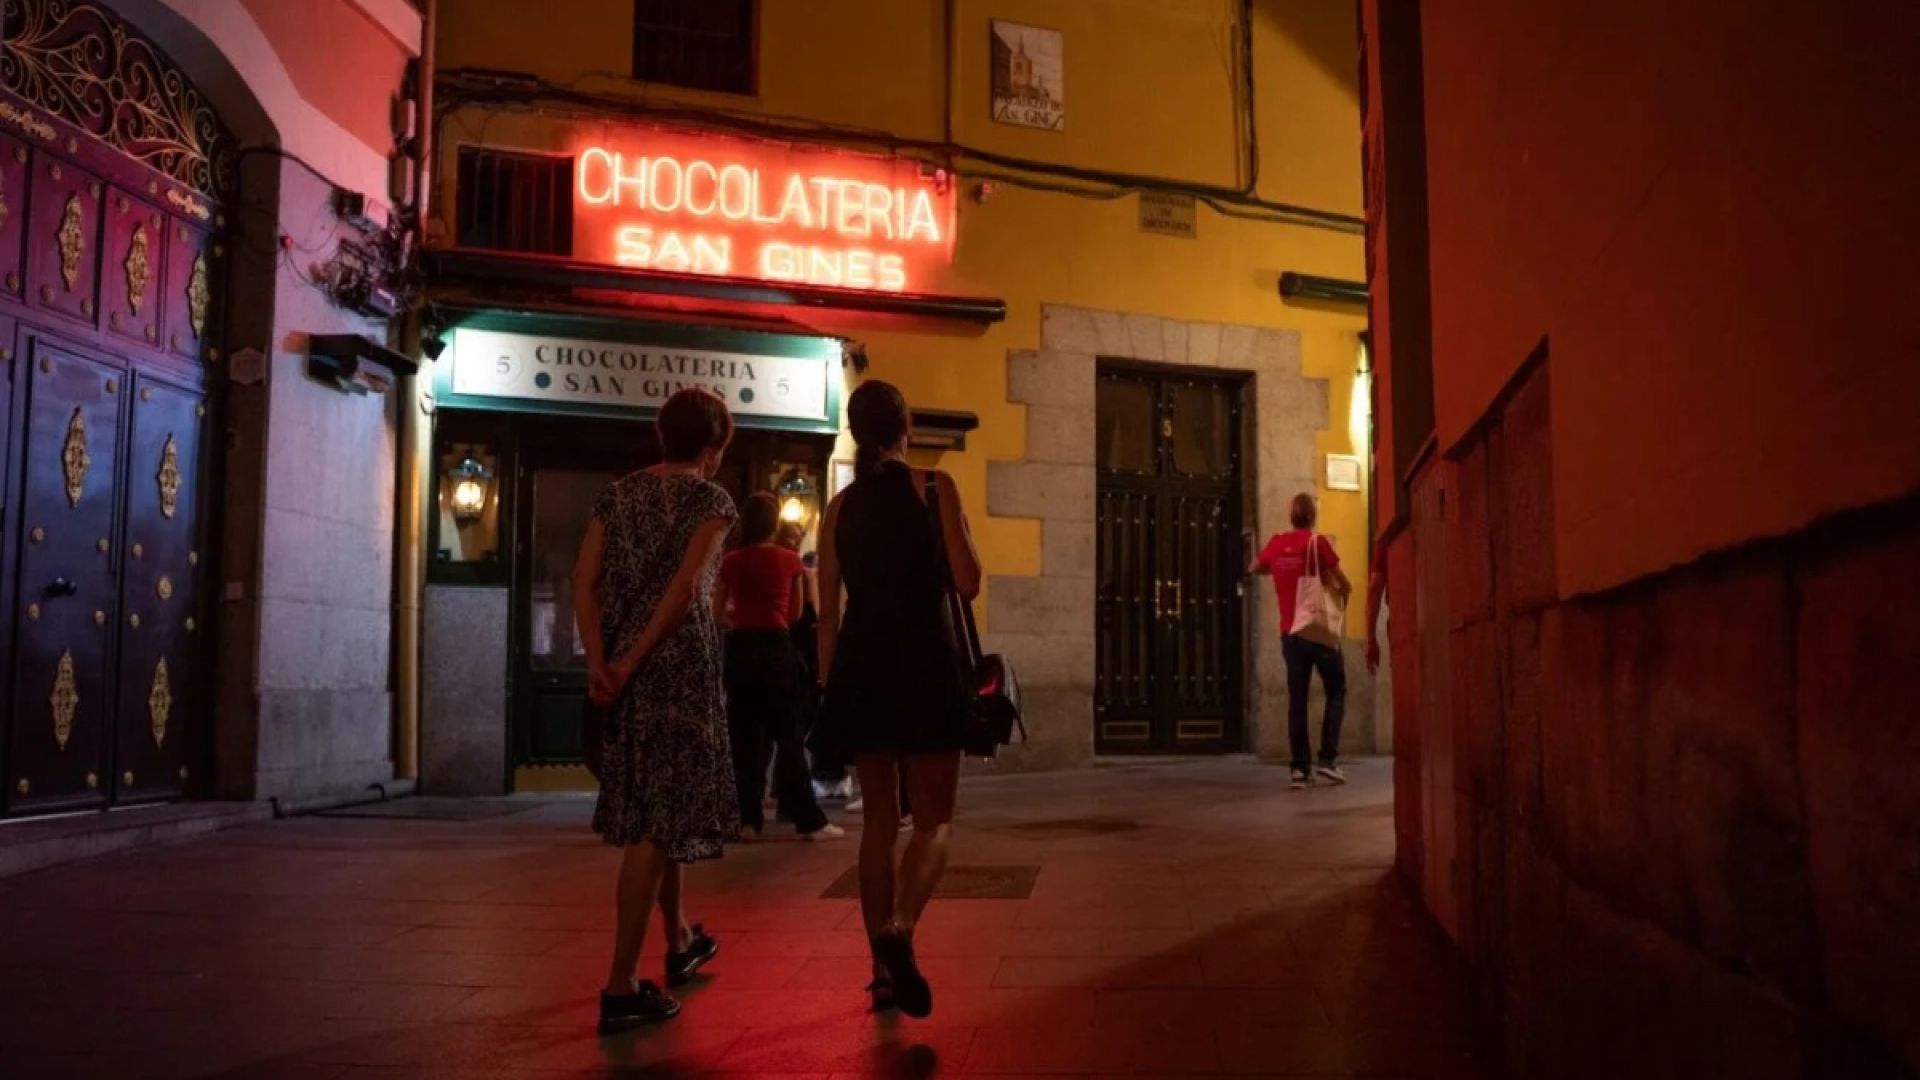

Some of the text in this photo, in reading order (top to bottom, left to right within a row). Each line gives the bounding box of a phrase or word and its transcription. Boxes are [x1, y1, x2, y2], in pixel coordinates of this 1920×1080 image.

[578, 146, 940, 242] CHOCOLATERIA
[615, 226, 906, 290] SAN GINES
[496, 355, 511, 375] 5
[535, 344, 756, 381] CHOCOLATERIA
[564, 372, 727, 399] SAN GIS
[776, 379, 790, 397] 5
